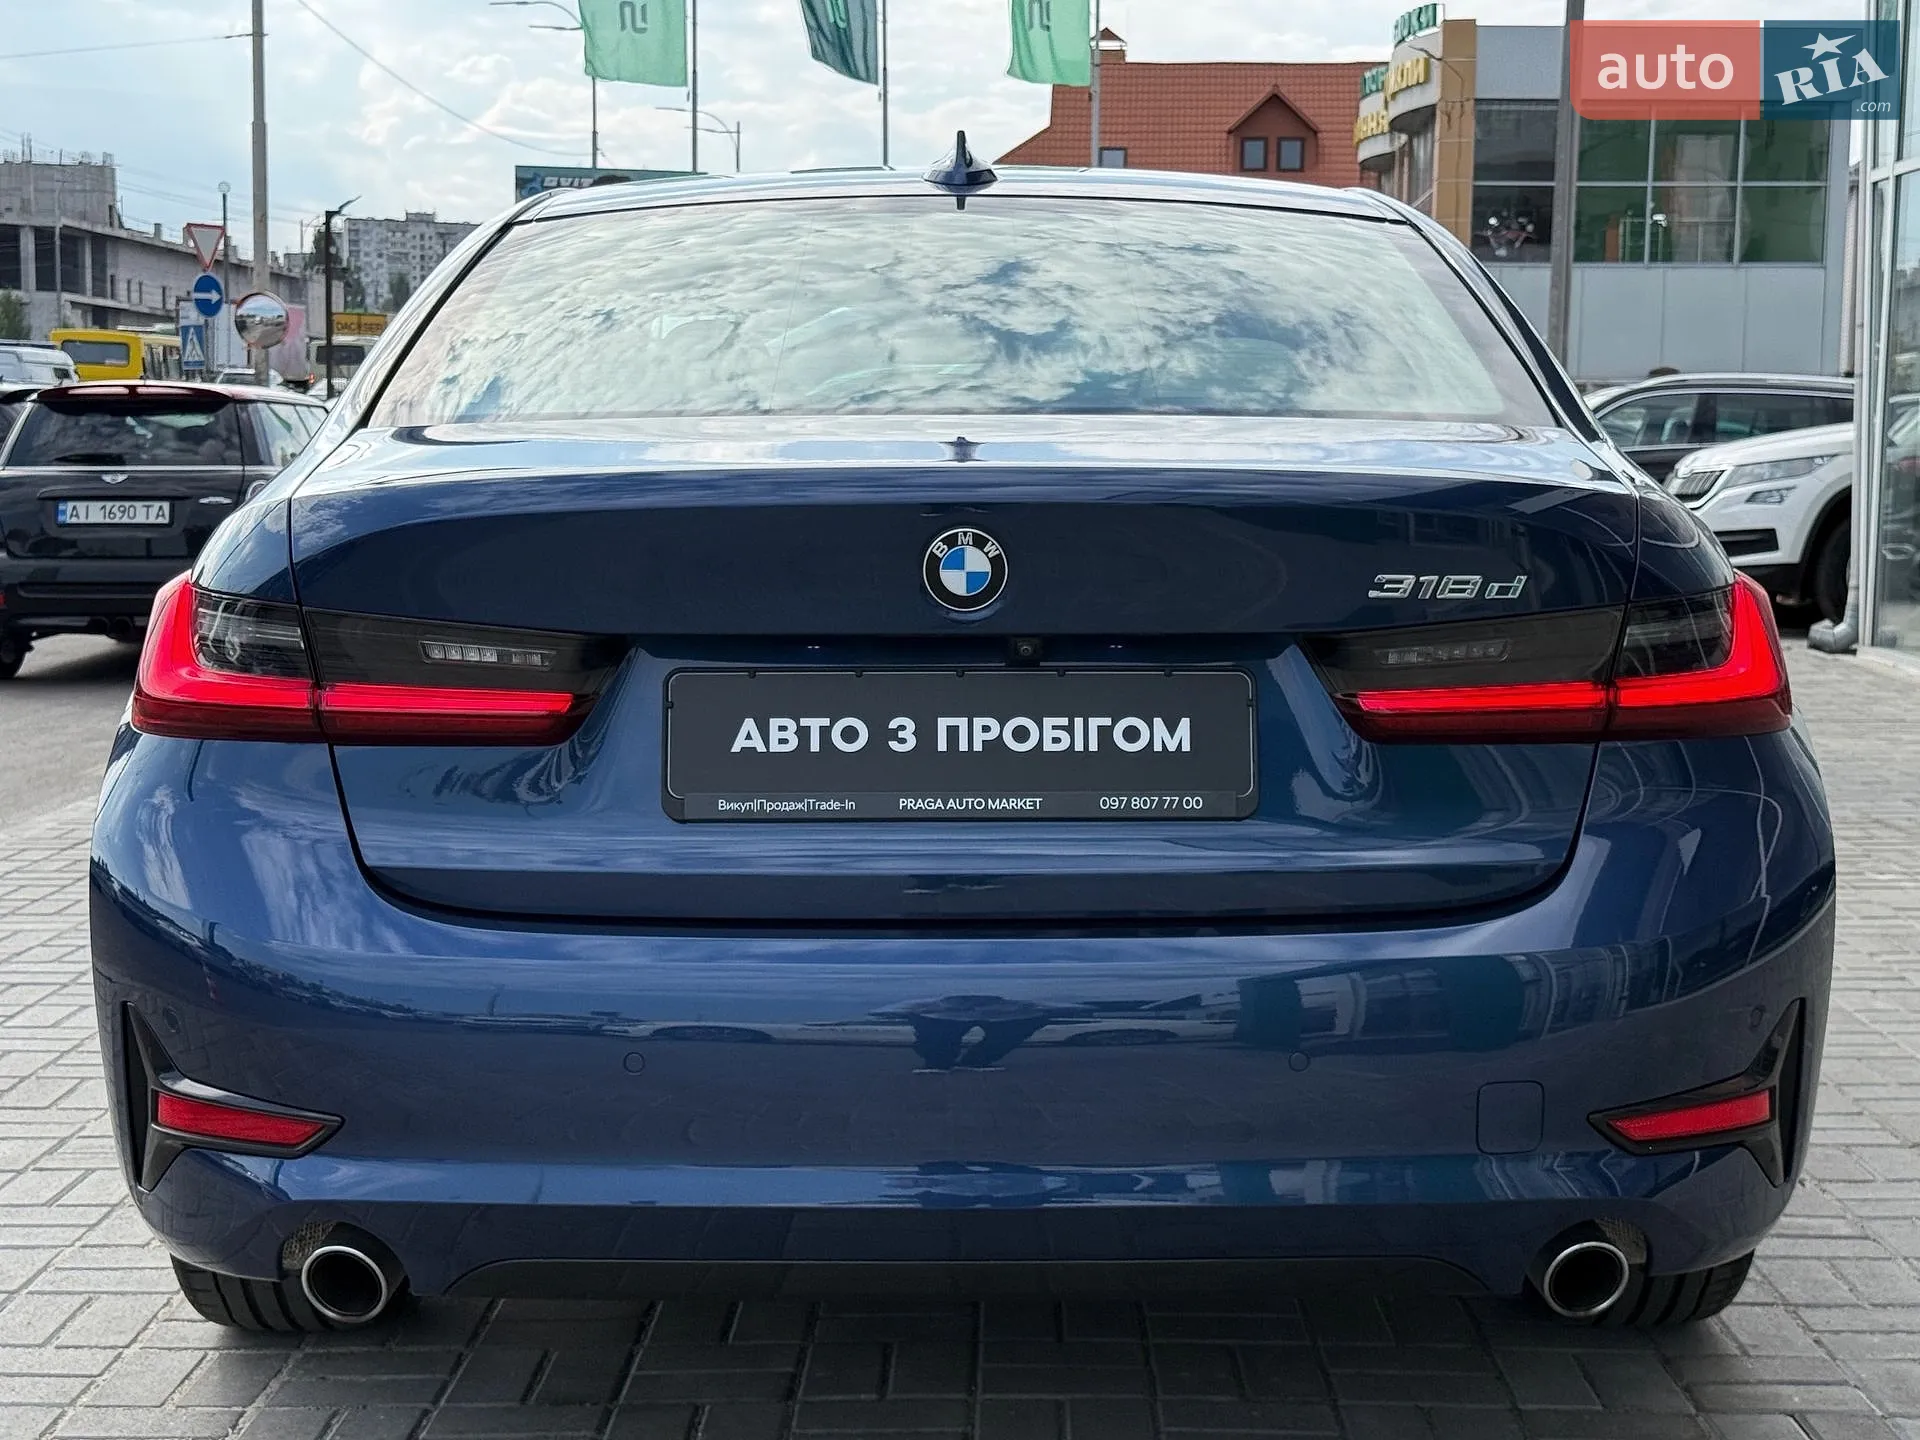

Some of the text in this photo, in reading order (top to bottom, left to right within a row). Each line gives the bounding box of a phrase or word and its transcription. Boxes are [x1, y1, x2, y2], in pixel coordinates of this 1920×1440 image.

[99, 504, 137, 520] 1690
[142, 504, 167, 520] TA
[931, 532, 1001, 559] BMW
[730, 717, 869, 752] АВТО
[937, 717, 1191, 752] ПРОБІГОМ
[899, 798, 1042, 810] PRAGA AUTO MARKET
[1100, 797, 1203, 809] 097 807 77 00
